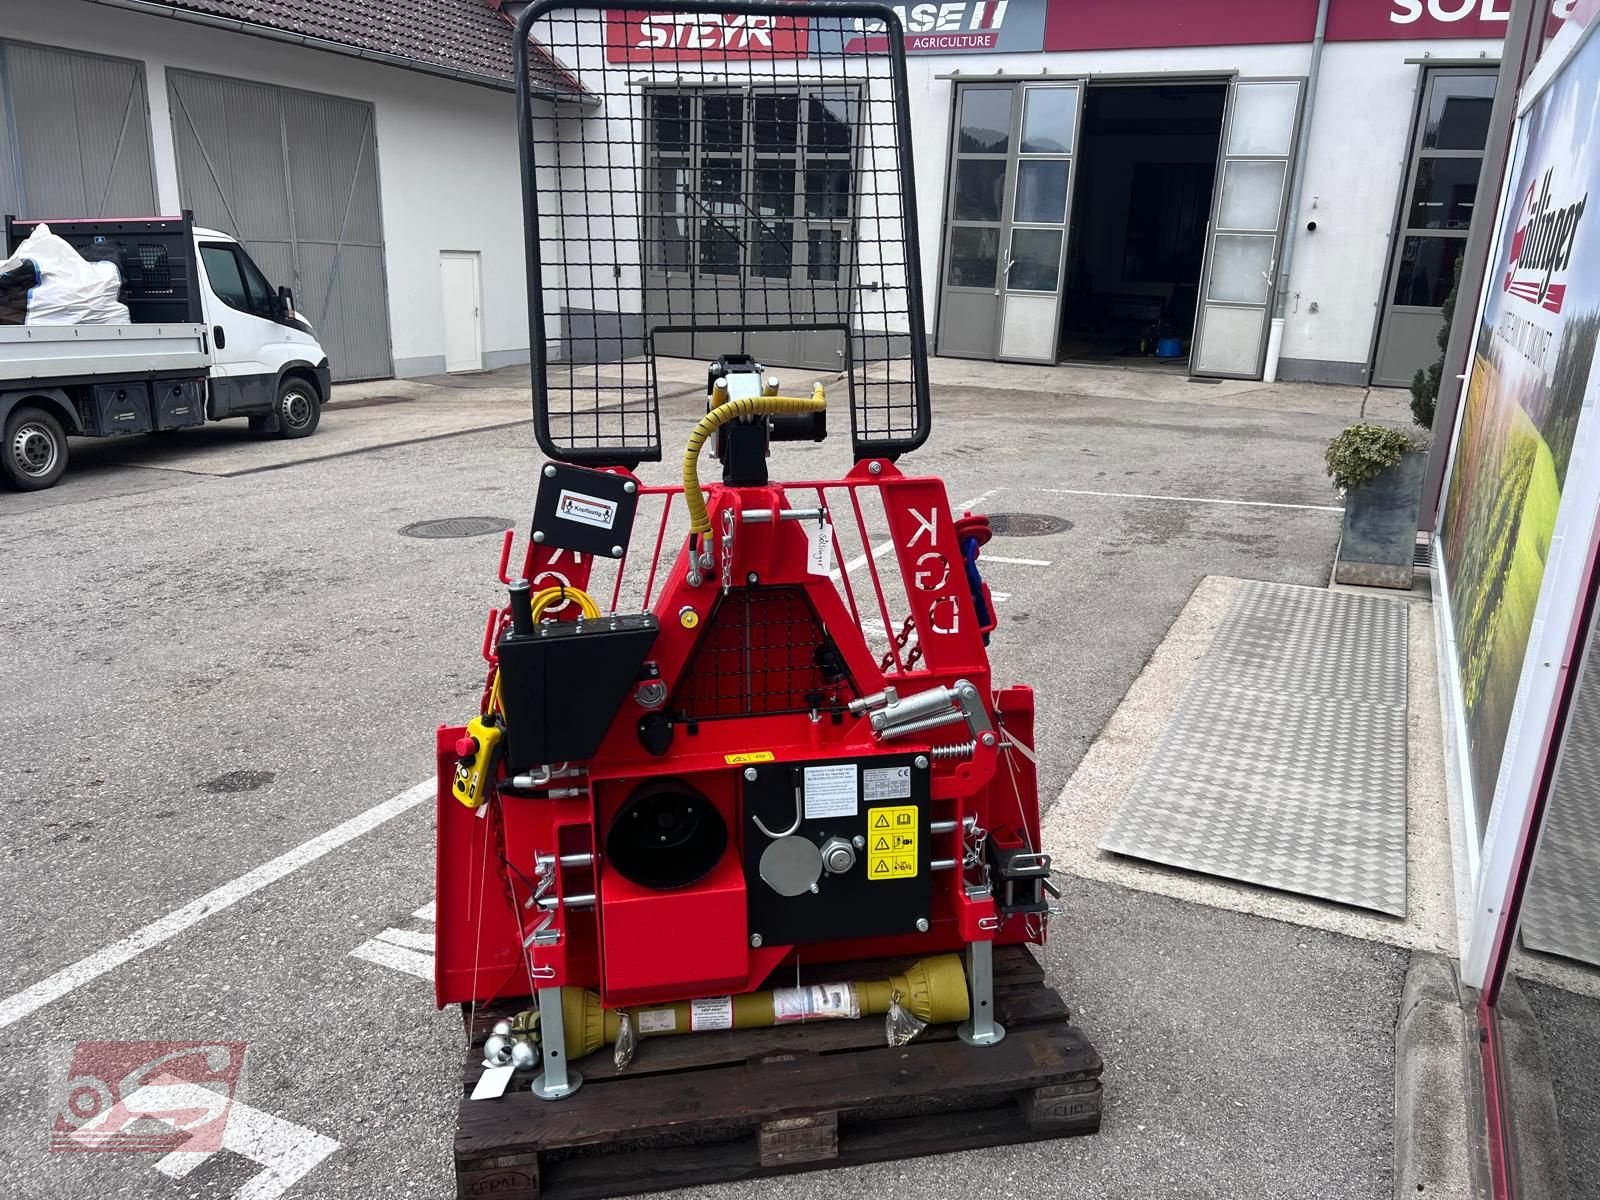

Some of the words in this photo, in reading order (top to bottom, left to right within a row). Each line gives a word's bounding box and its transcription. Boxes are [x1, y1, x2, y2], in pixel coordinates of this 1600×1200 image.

[635, 13, 776, 49] STEYR
[913, 36, 990, 48] AGRICULTURE
[1504, 166, 1588, 304] Söllinger
